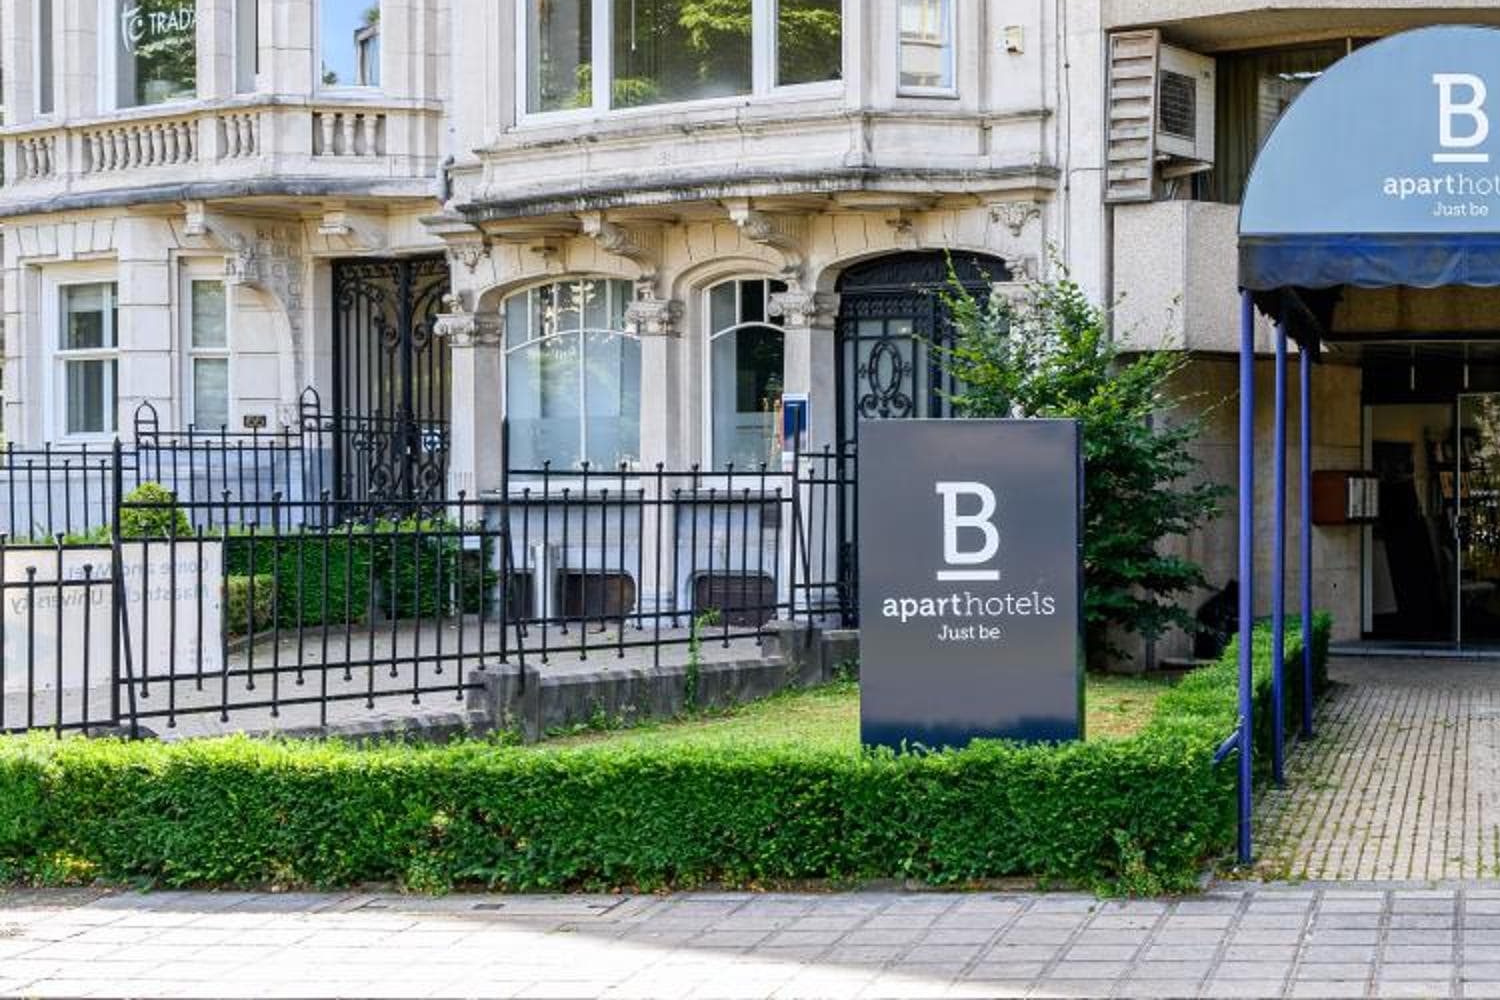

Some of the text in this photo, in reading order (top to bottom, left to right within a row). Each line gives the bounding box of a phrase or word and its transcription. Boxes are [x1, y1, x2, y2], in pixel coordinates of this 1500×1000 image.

[1432, 73, 1489, 148] B
[1433, 202, 1489, 217] Just be
[935, 481, 1000, 565] B
[882, 592, 1056, 622] aparthotels
[937, 625, 1001, 641] Just be
